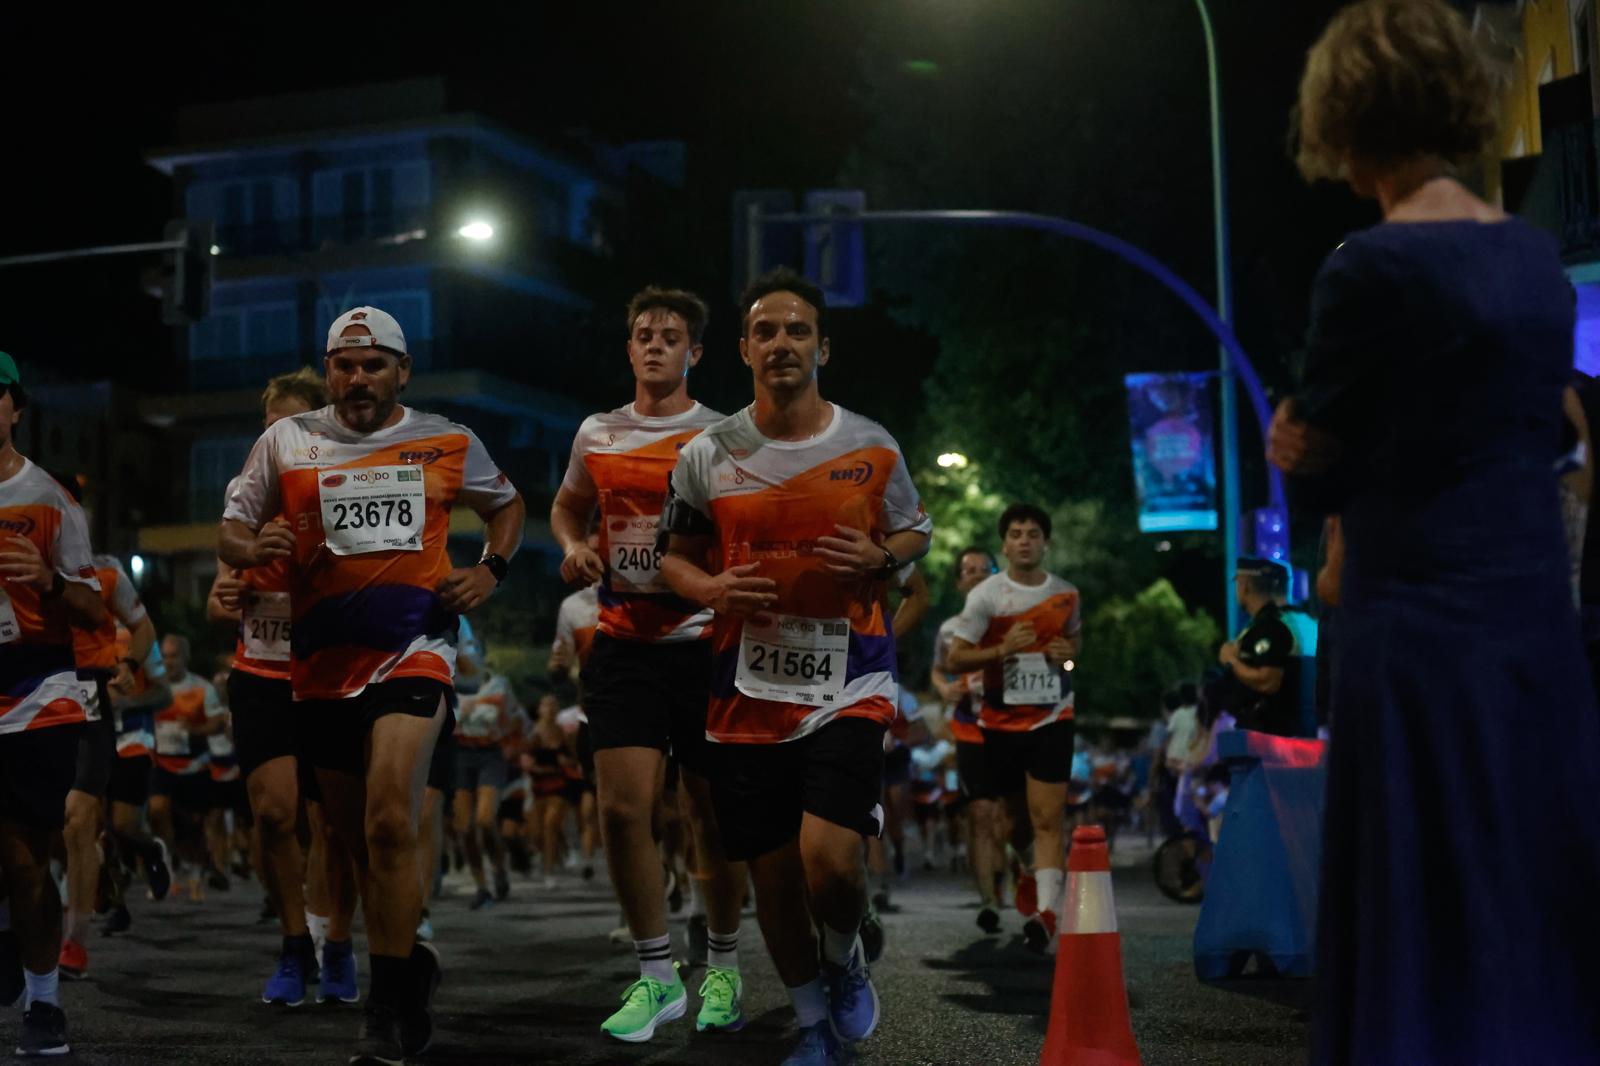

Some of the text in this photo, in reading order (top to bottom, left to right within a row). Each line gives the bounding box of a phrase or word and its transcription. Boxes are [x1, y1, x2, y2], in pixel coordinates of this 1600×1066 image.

[829, 466, 865, 482] KH7
[333, 499, 413, 531] 23678
[749, 644, 832, 681] 21564
[1010, 672, 1054, 690] 21712
